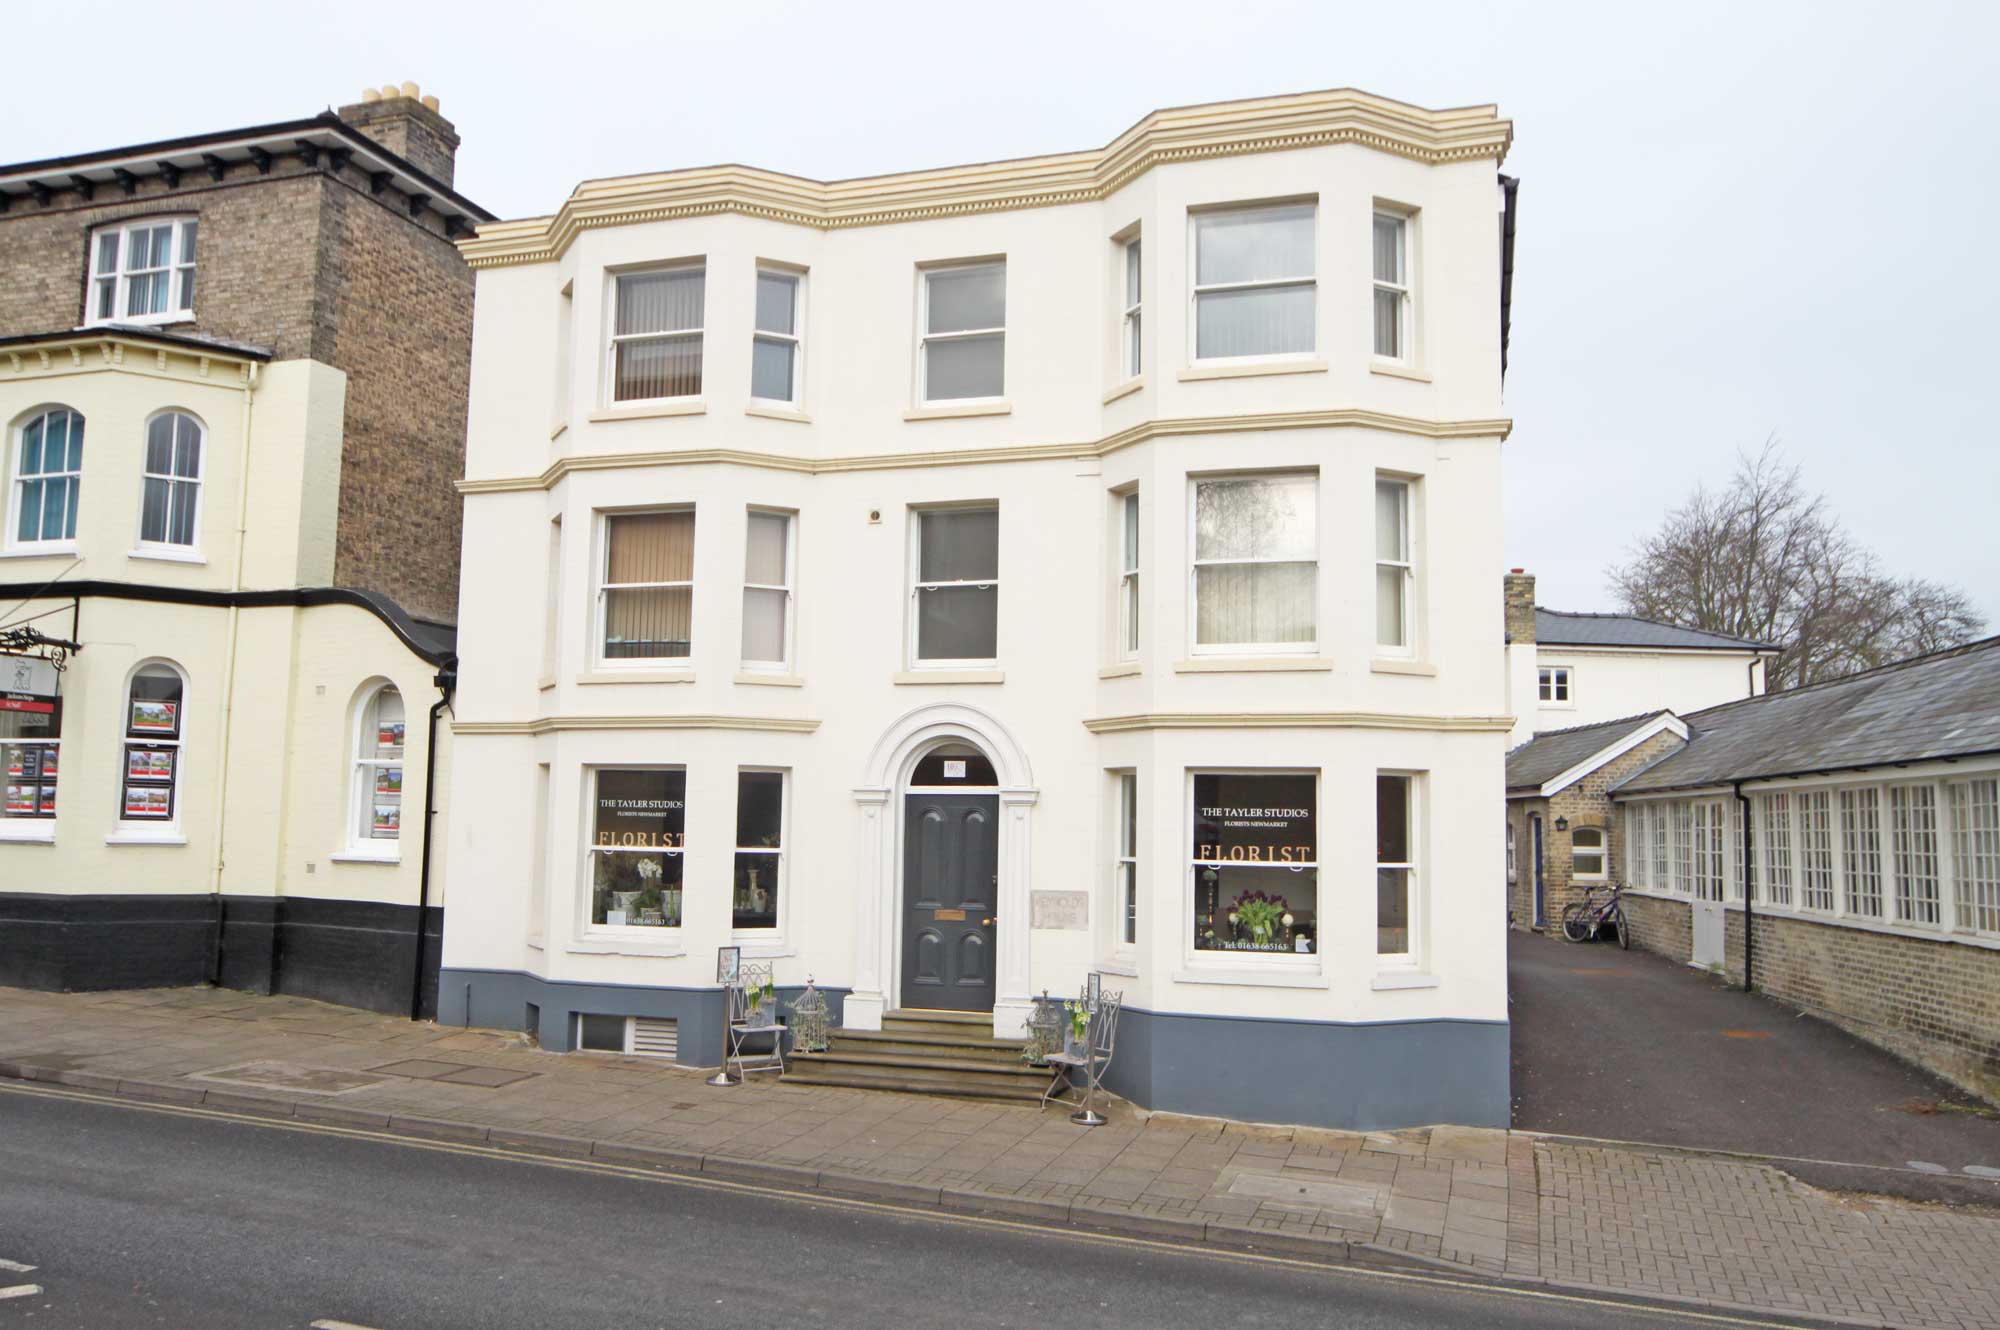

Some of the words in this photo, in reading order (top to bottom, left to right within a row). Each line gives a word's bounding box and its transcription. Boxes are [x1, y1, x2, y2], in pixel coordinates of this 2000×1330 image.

[600, 799, 616, 807] THE
[617, 799, 648, 808] TAYLER
[649, 800, 684, 809] STUDIOS
[1201, 807, 1222, 816] THE
[1224, 808, 1263, 817] TAYLER
[1264, 808, 1309, 818] STUDIOS
[599, 832, 684, 847] FLORIST
[1200, 845, 1311, 862] FLORIST
